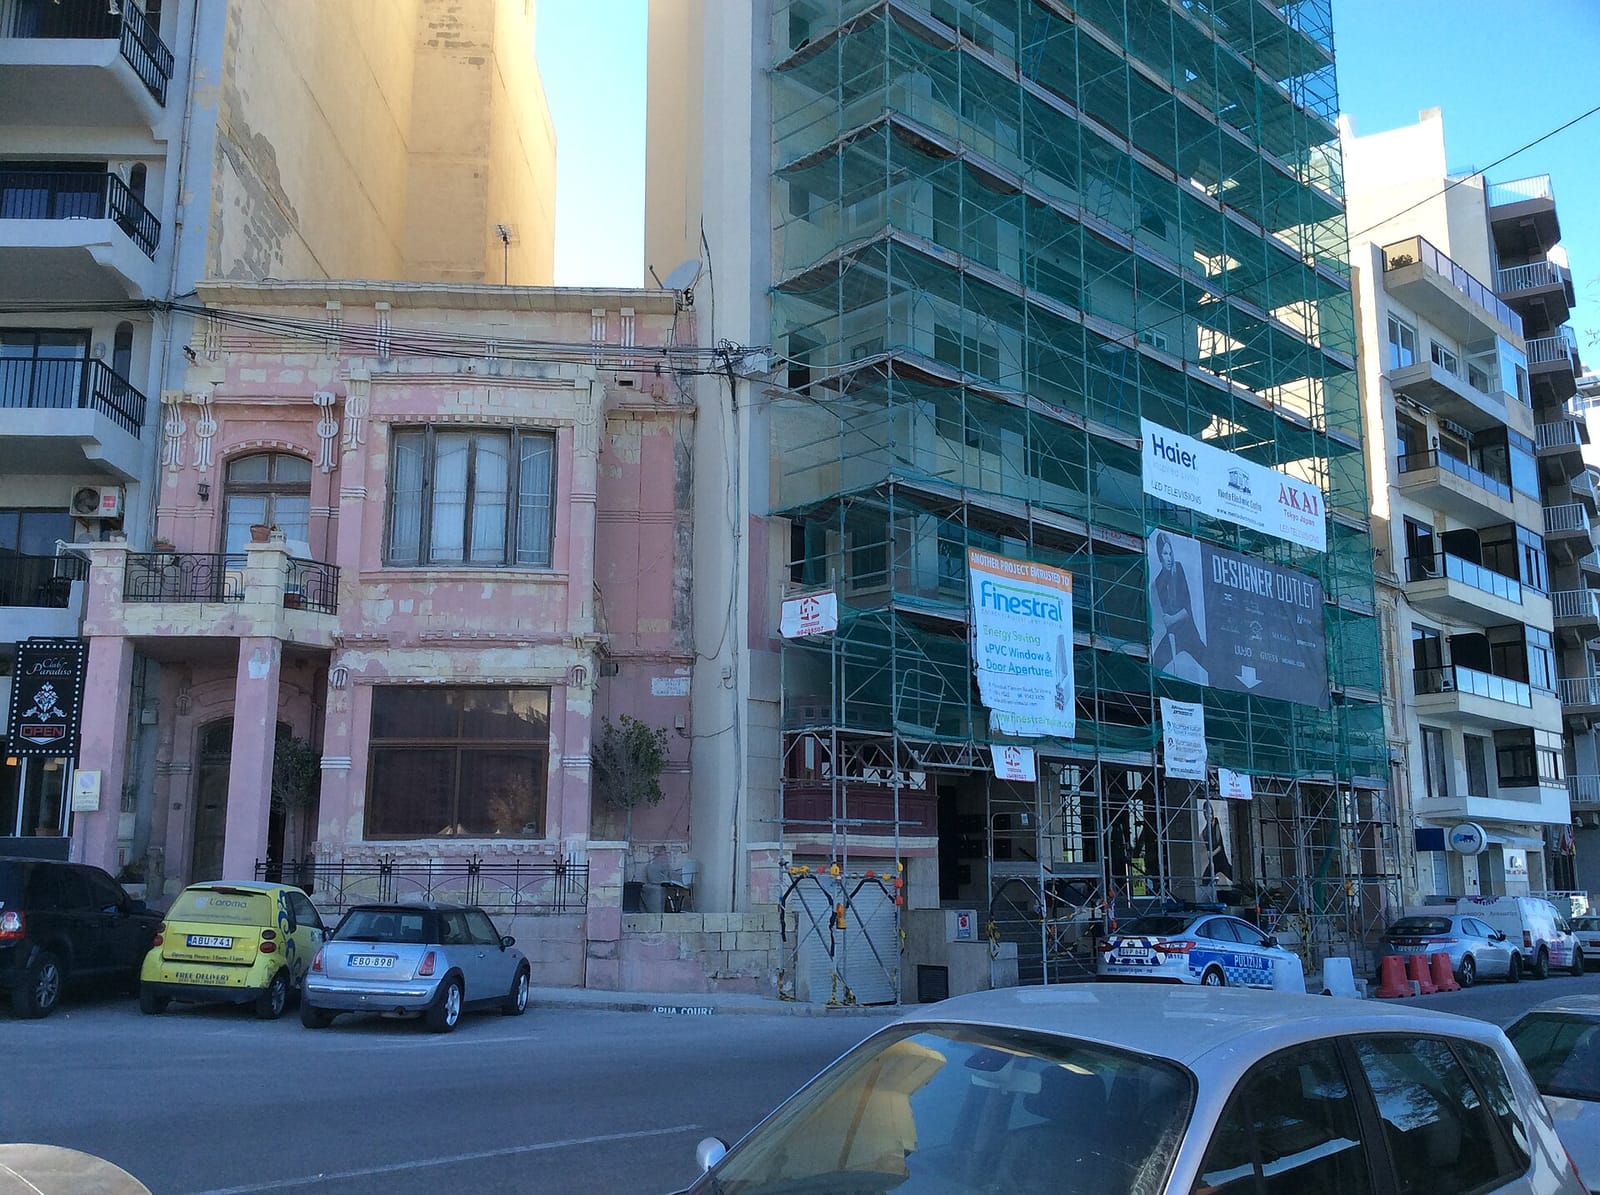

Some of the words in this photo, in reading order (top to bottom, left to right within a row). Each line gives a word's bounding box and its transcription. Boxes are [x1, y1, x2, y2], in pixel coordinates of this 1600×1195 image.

[1151, 433, 1197, 470] Haier
[1151, 480, 1163, 491] LED
[1164, 484, 1202, 504] TELEVISIONS
[1278, 482, 1319, 517] AKAI
[970, 551, 1000, 569] ANOTHER
[1000, 557, 1030, 576] PROJECT
[1062, 574, 1070, 586] TO
[1211, 554, 1274, 599] DESIGNER
[1275, 573, 1315, 610] OUTLET
[980, 580, 1063, 623] Finestral
[983, 624, 1011, 642] Energy
[1012, 630, 1041, 646] Saving
[42, 658, 62, 669] Club
[1008, 647, 1045, 661] Window
[26, 662, 72, 676] Paradiso
[985, 658, 1007, 672] Door
[1008, 661, 1054, 678] Apertures
[23, 726, 63, 737] OPEN
[209, 898, 248, 909] L'aroma
[1233, 953, 1264, 970] PULIZIJA
[176, 971, 192, 979] FREE
[195, 973, 229, 981] DELIVERY
